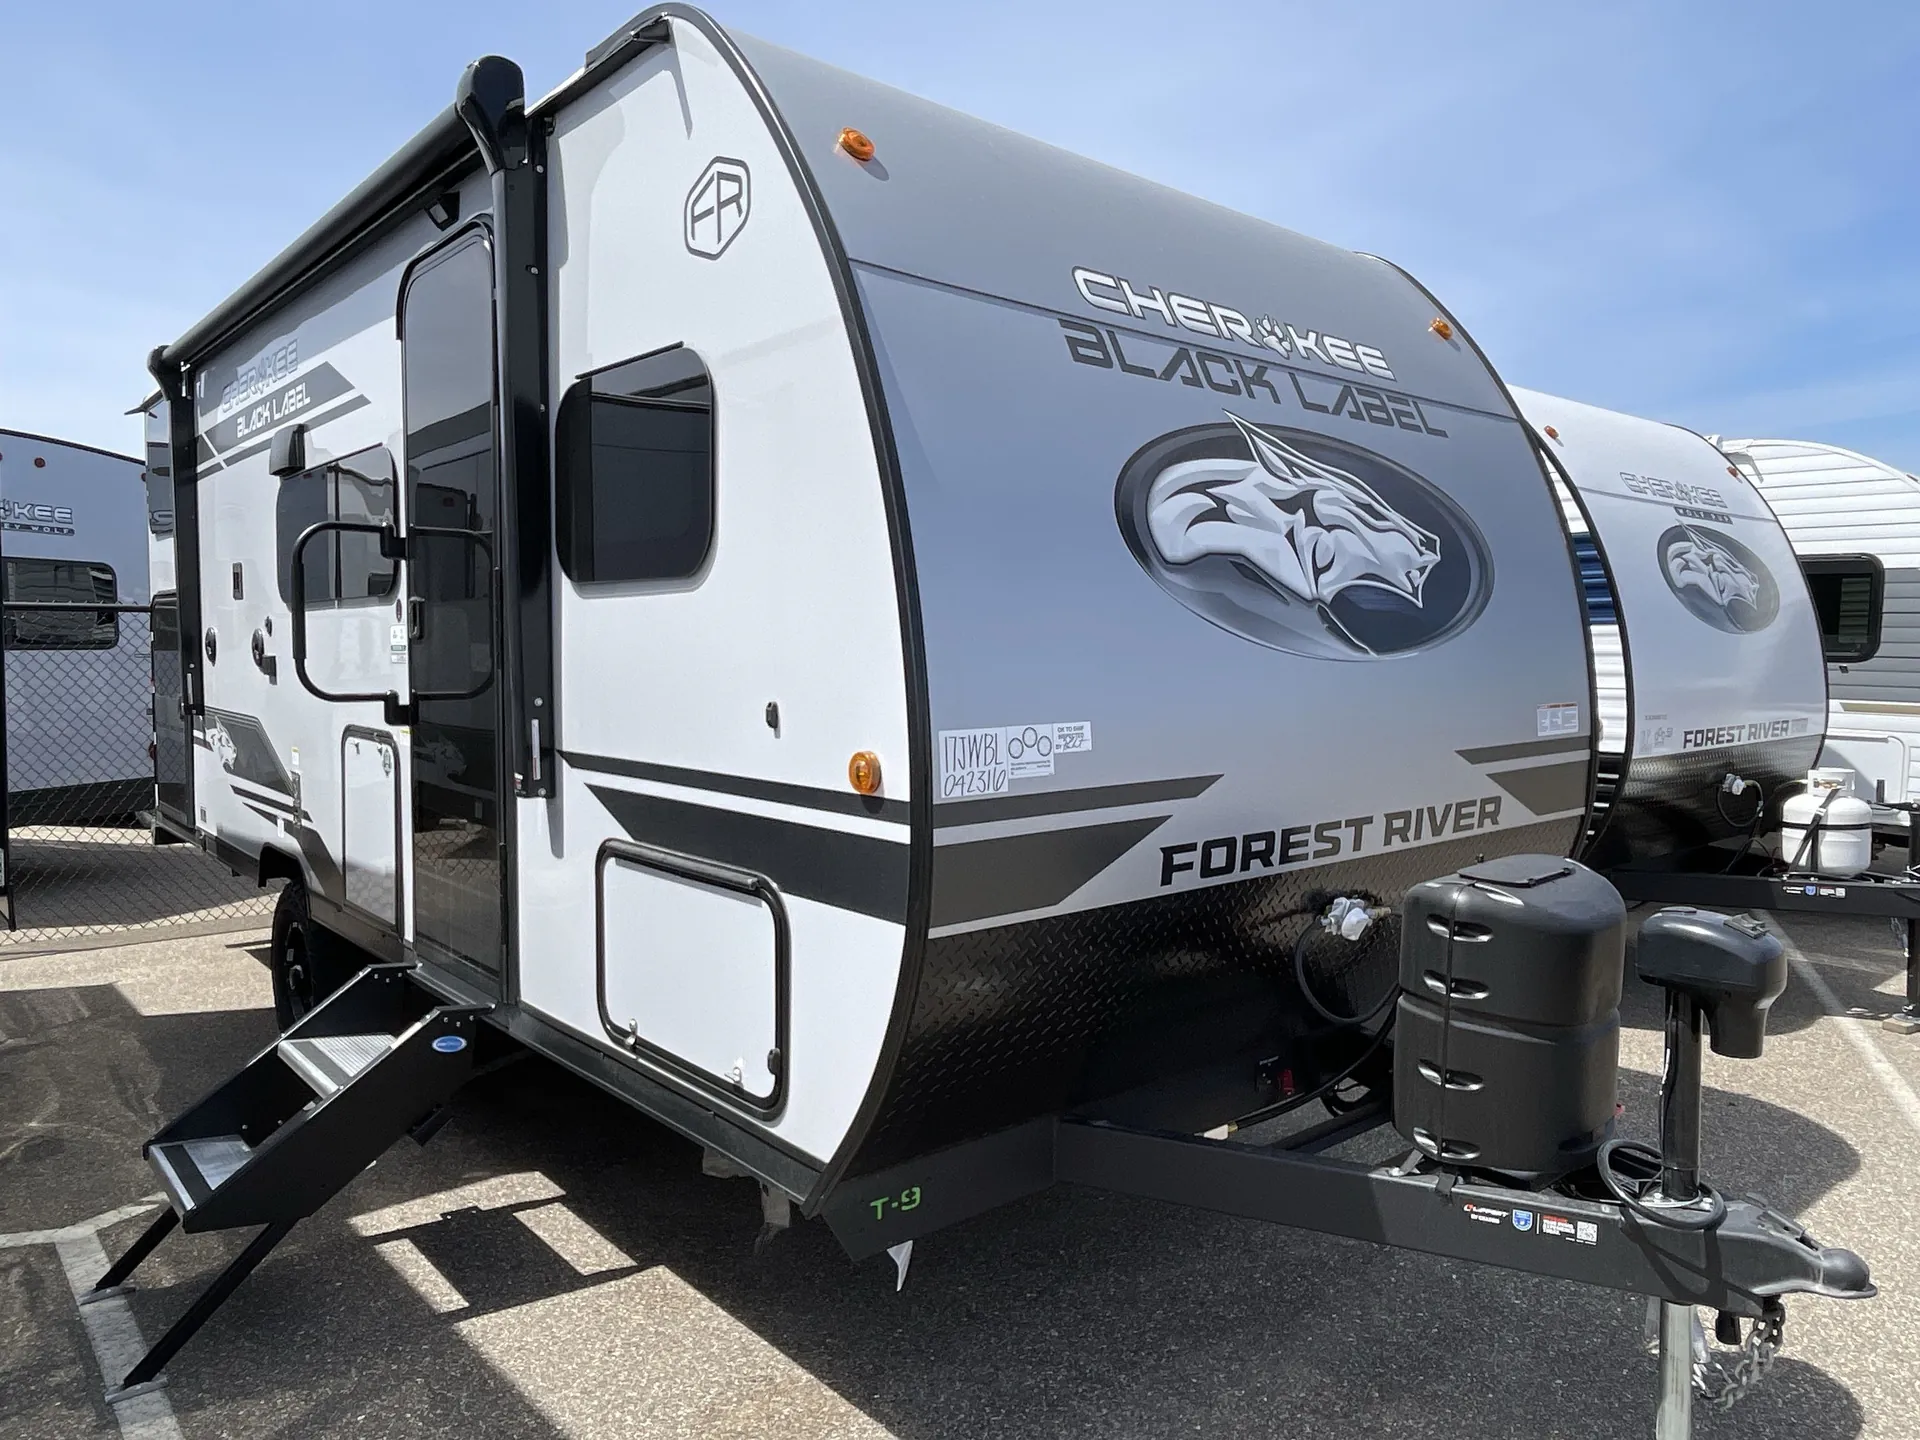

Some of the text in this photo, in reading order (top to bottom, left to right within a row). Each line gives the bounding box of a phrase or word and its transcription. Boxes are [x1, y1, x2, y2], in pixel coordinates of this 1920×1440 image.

[1058, 318, 1449, 438] BLACK LABEL
[236, 382, 311, 438] BLACK LABEL
[31, 525, 69, 534] WOLF
[1683, 724, 1746, 749] FOREST
[1747, 720, 1790, 741] RIVER
[1159, 795, 1503, 887] FOREST RIVER
